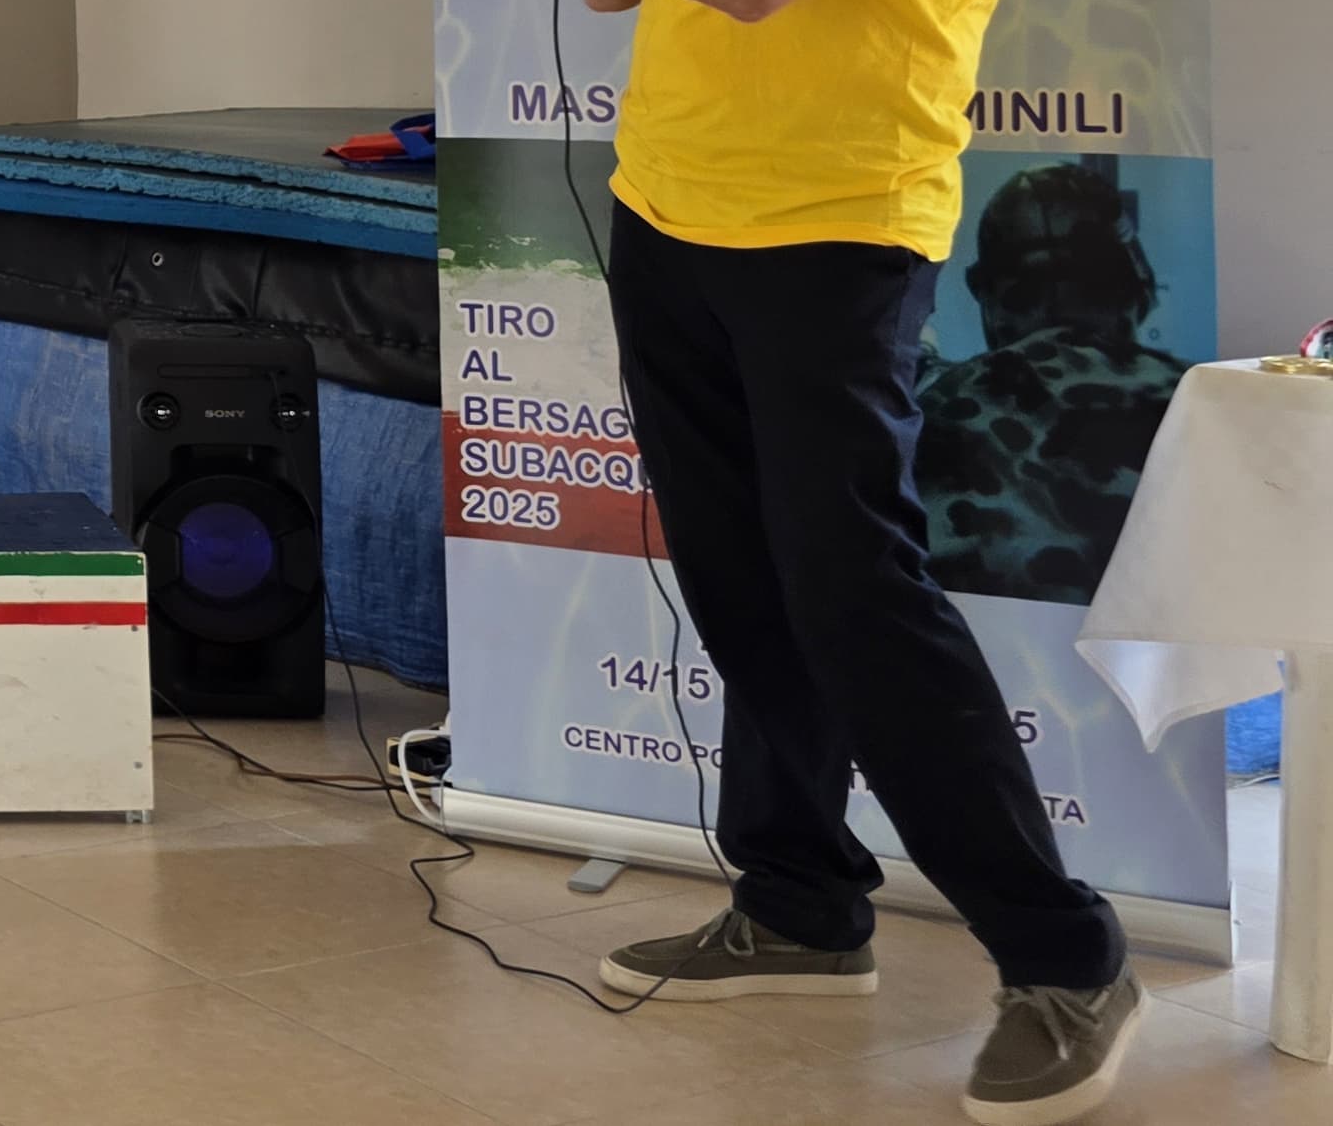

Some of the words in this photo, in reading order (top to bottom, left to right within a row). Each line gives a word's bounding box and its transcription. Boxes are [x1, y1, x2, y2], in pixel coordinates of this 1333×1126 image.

[965, 91, 1123, 134] INILI
[460, 303, 555, 337] TIRO
[462, 349, 513, 382] AL
[204, 409, 245, 418] SONY
[464, 396, 631, 439] BERSAG
[465, 442, 649, 491] SUBACQ
[465, 489, 556, 526] 2025
[601, 657, 710, 700] 14/15
[565, 727, 682, 763] CENTRO
